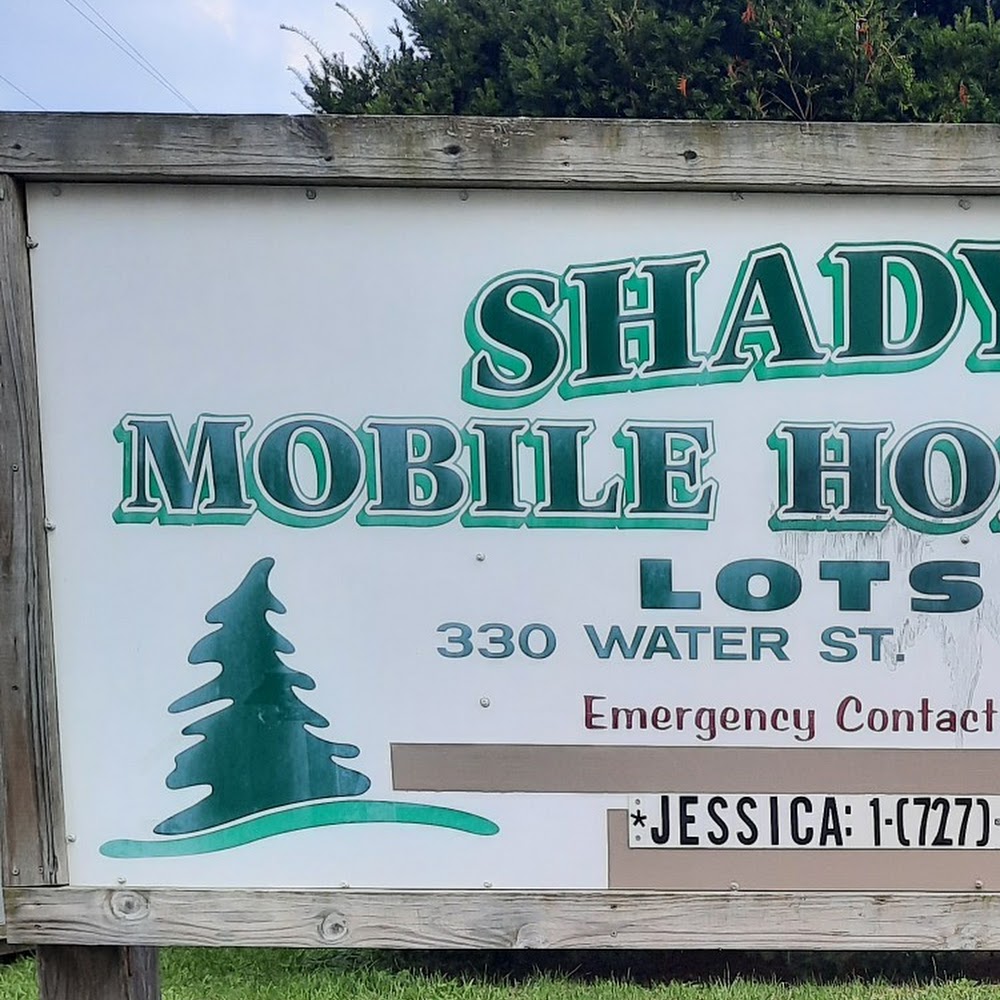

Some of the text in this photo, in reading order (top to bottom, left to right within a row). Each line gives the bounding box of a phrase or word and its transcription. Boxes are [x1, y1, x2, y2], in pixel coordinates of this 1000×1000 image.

[112, 413, 719, 530] MOBILE
[640, 558, 984, 613] LOTS
[436, 622, 557, 660] 330
[584, 625, 790, 661] WATER
[819, 626, 905, 662] ST.
[583, 695, 816, 741] Emergency
[837, 696, 998, 732] Contact
